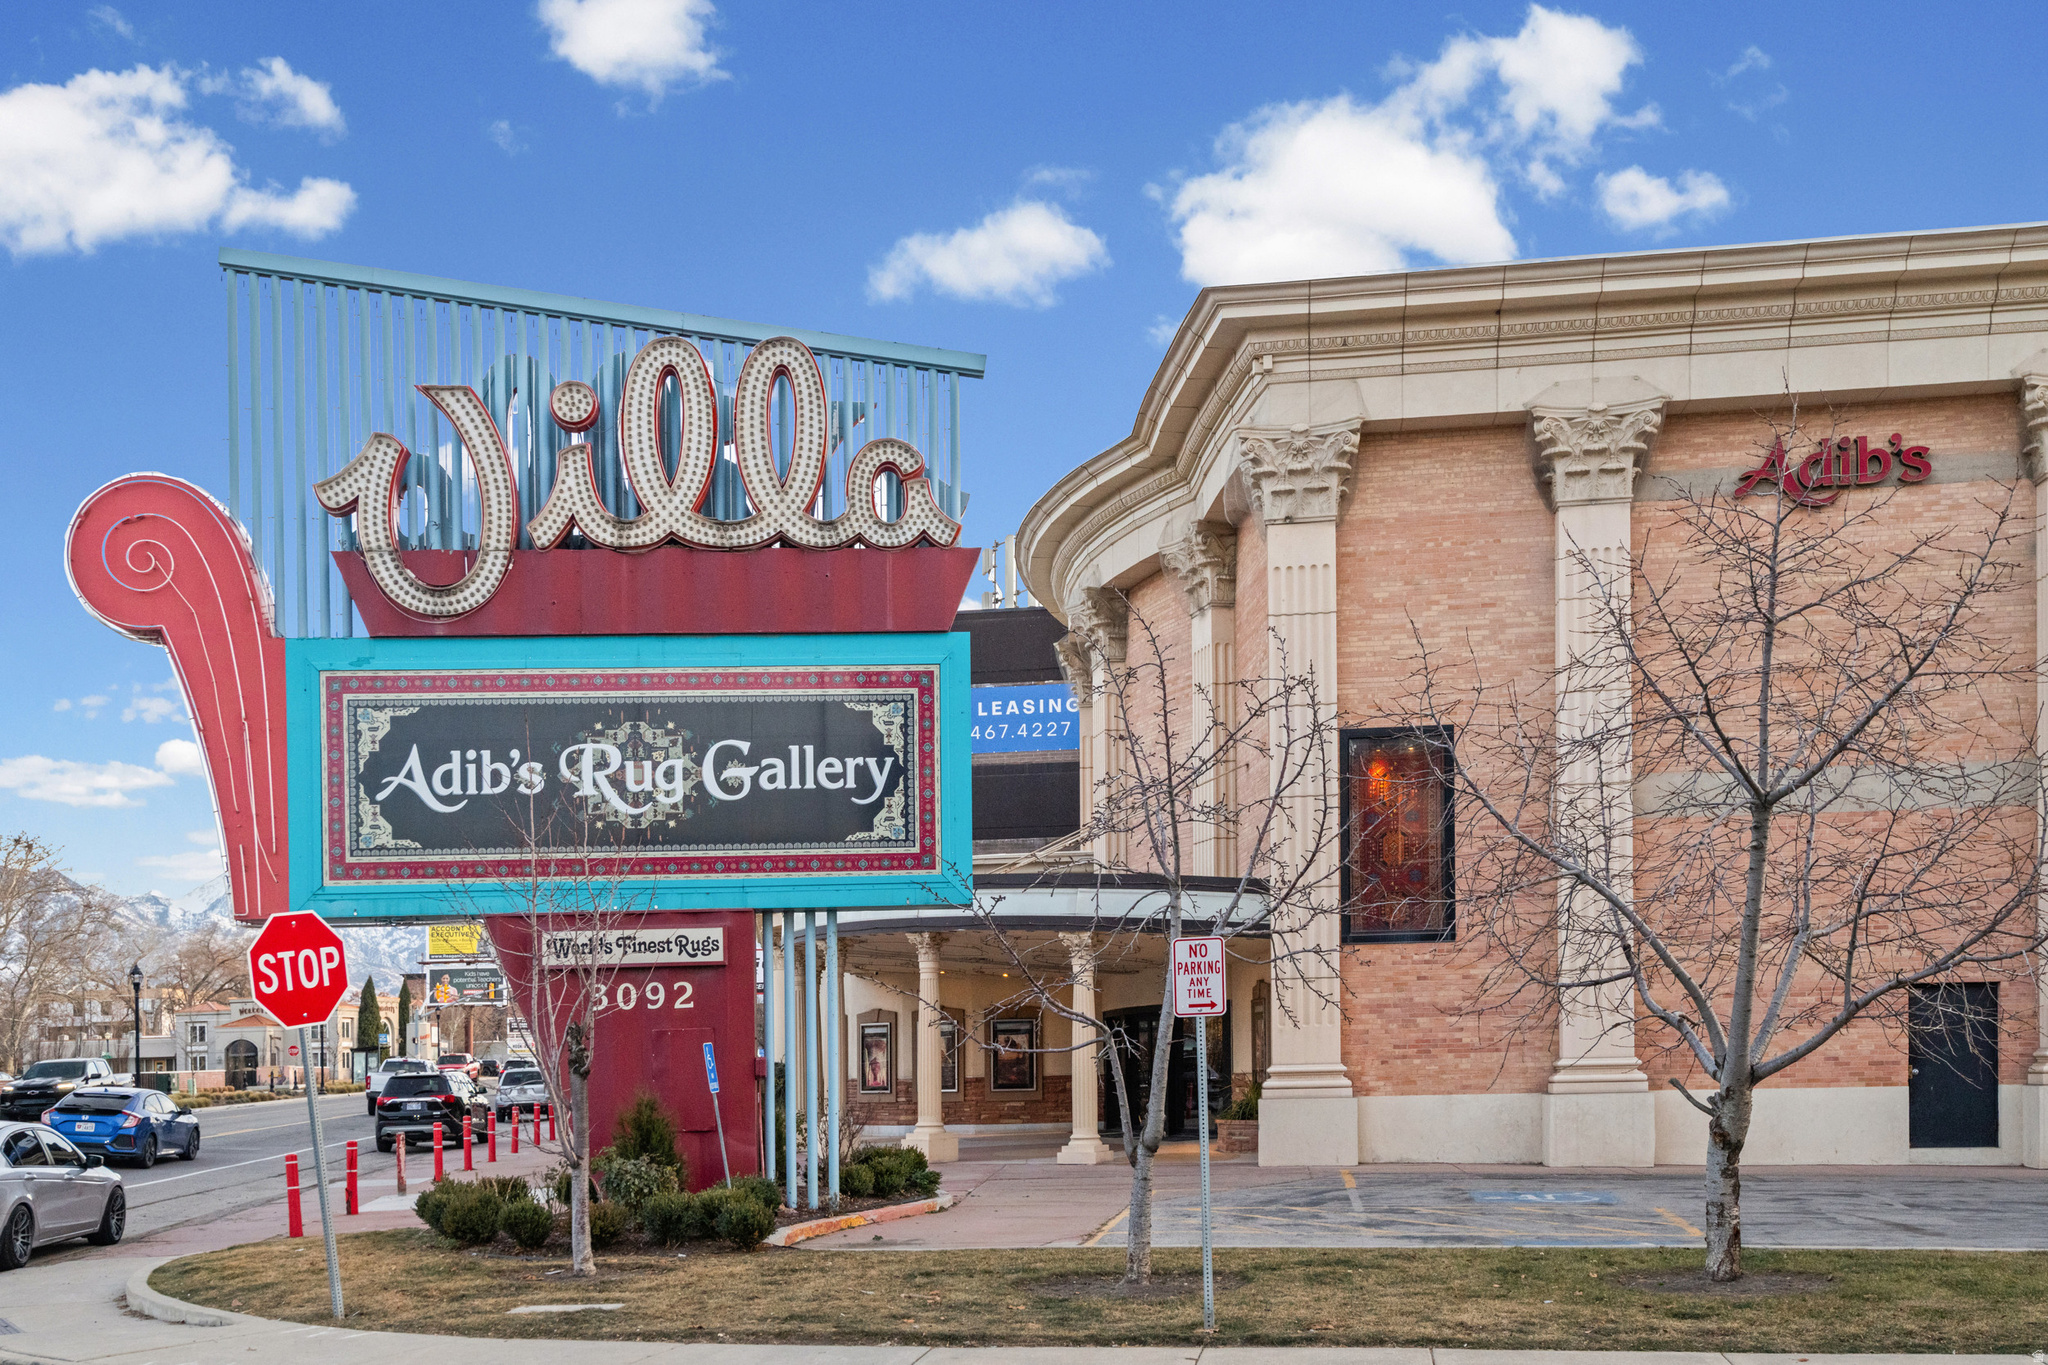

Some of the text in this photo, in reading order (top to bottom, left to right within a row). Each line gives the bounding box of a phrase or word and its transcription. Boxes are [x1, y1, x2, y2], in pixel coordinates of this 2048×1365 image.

[313, 335, 961, 621] Villa
[1734, 432, 1933, 508] Adib's
[977, 697, 1080, 716] LEASING
[970, 721, 1071, 740] 467.4227
[375, 739, 895, 815] Adib's Rug Gallery
[615, 935, 673, 956] Finest
[674, 934, 720, 959] Rugs
[1188, 943, 1208, 958] NO
[257, 945, 341, 995] STOP
[1177, 960, 1221, 976] PARKING
[1188, 976, 1210, 987] ANY
[592, 981, 695, 1011] 3092
[1187, 987, 1213, 999] TIME
